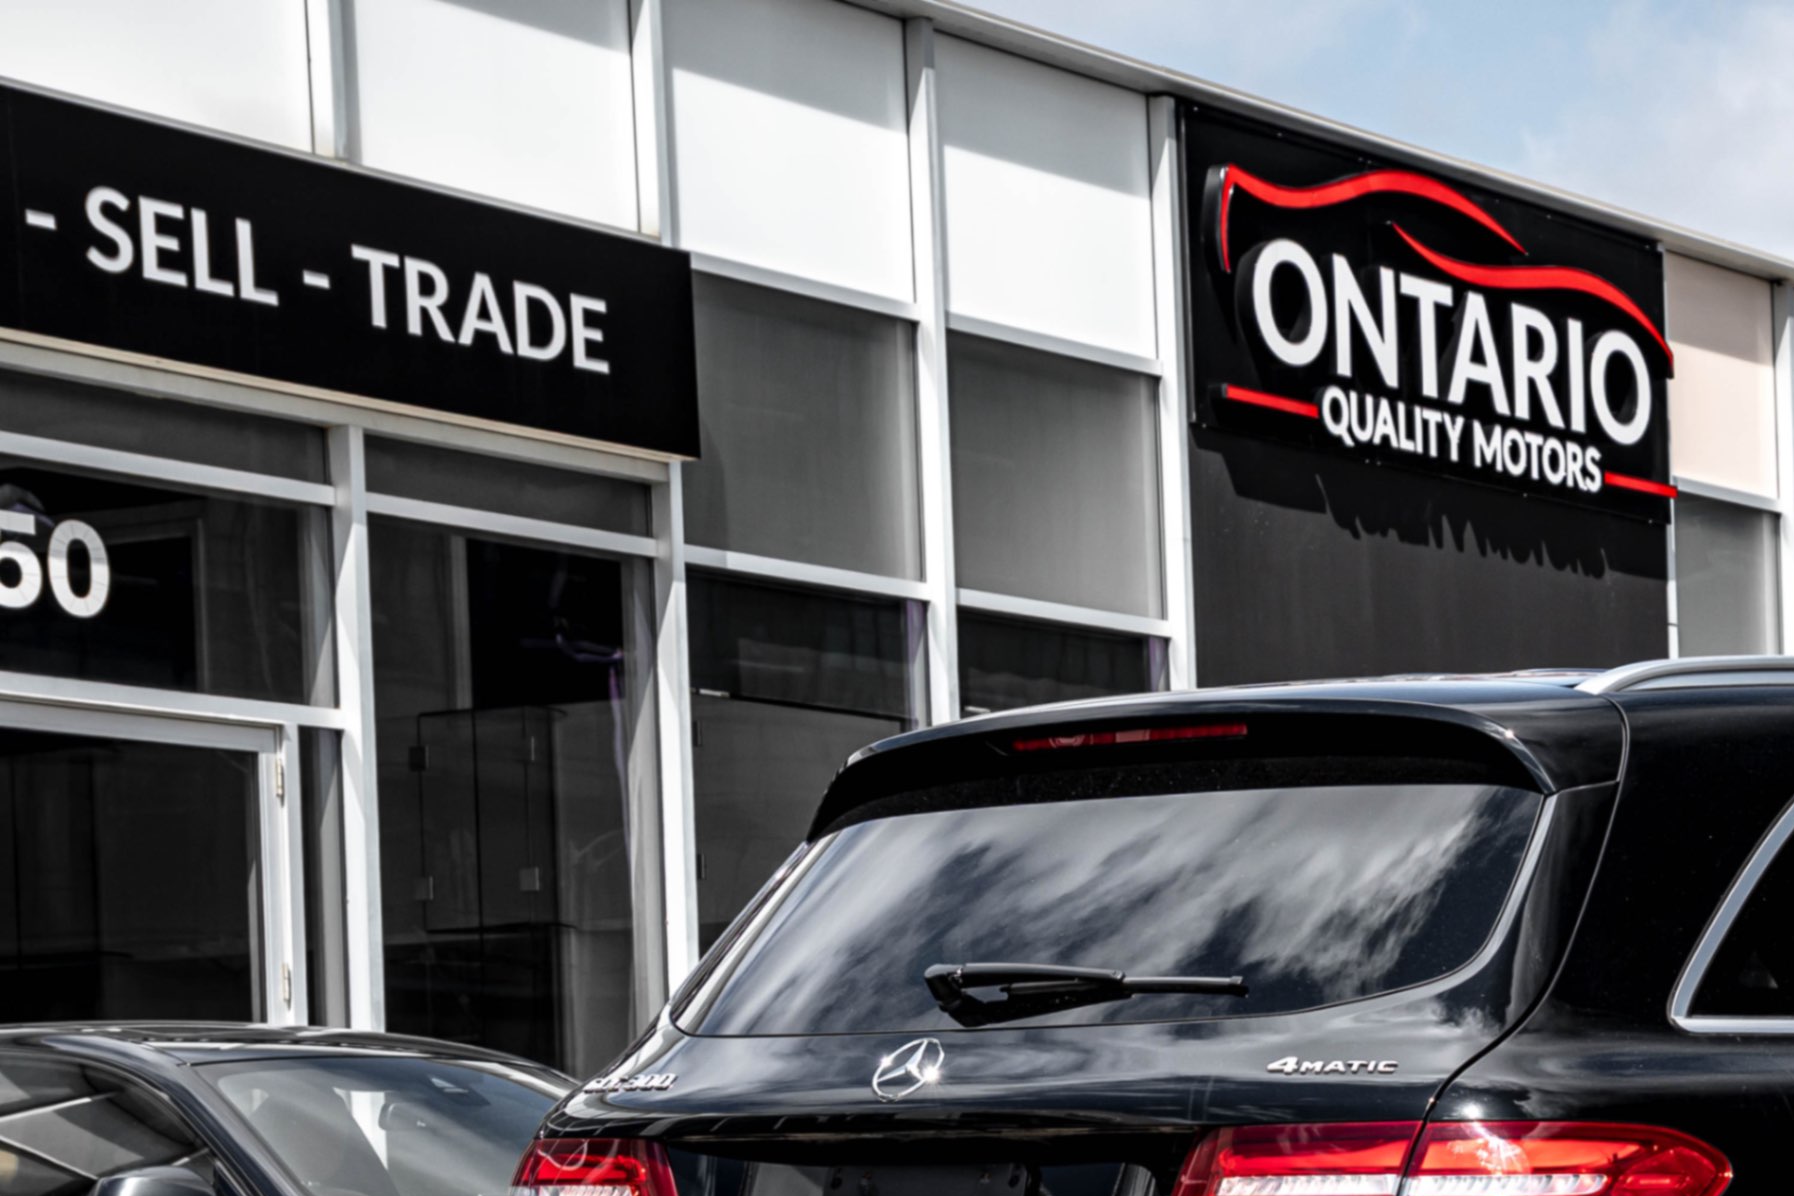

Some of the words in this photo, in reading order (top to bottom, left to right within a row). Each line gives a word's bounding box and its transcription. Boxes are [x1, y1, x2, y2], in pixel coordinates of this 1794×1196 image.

[85, 186, 279, 306] SELL
[350, 243, 611, 374] TRADE
[1252, 238, 1652, 446] ONTARIO
[1321, 385, 1466, 462] QUALITY
[1472, 418, 1603, 493] MOTORS
[1266, 1056, 1399, 1074] 4MATIC
